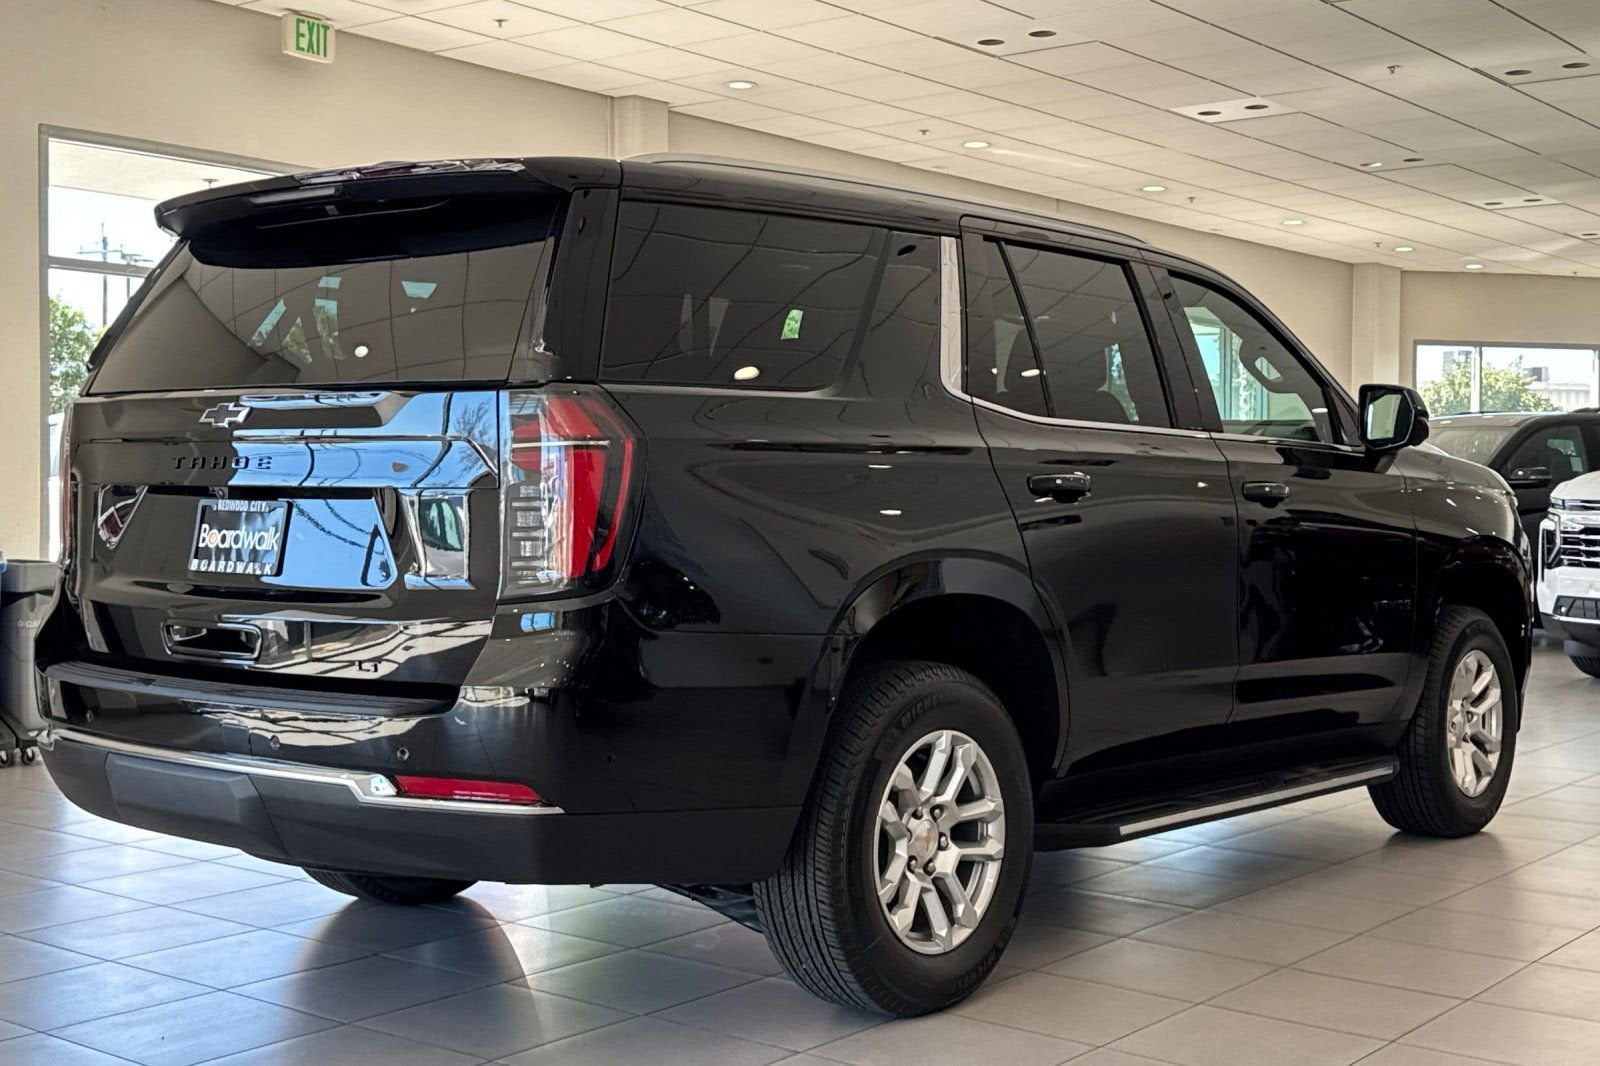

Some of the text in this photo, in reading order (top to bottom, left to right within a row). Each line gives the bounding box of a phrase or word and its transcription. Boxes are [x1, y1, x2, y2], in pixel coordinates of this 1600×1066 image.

[296, 17, 330, 58] EXIT
[173, 456, 272, 470] TAHOE
[217, 499, 267, 512] REDWOOD CITY
[198, 523, 280, 551] Boardwalk
[190, 558, 273, 575] BOARDWALK
